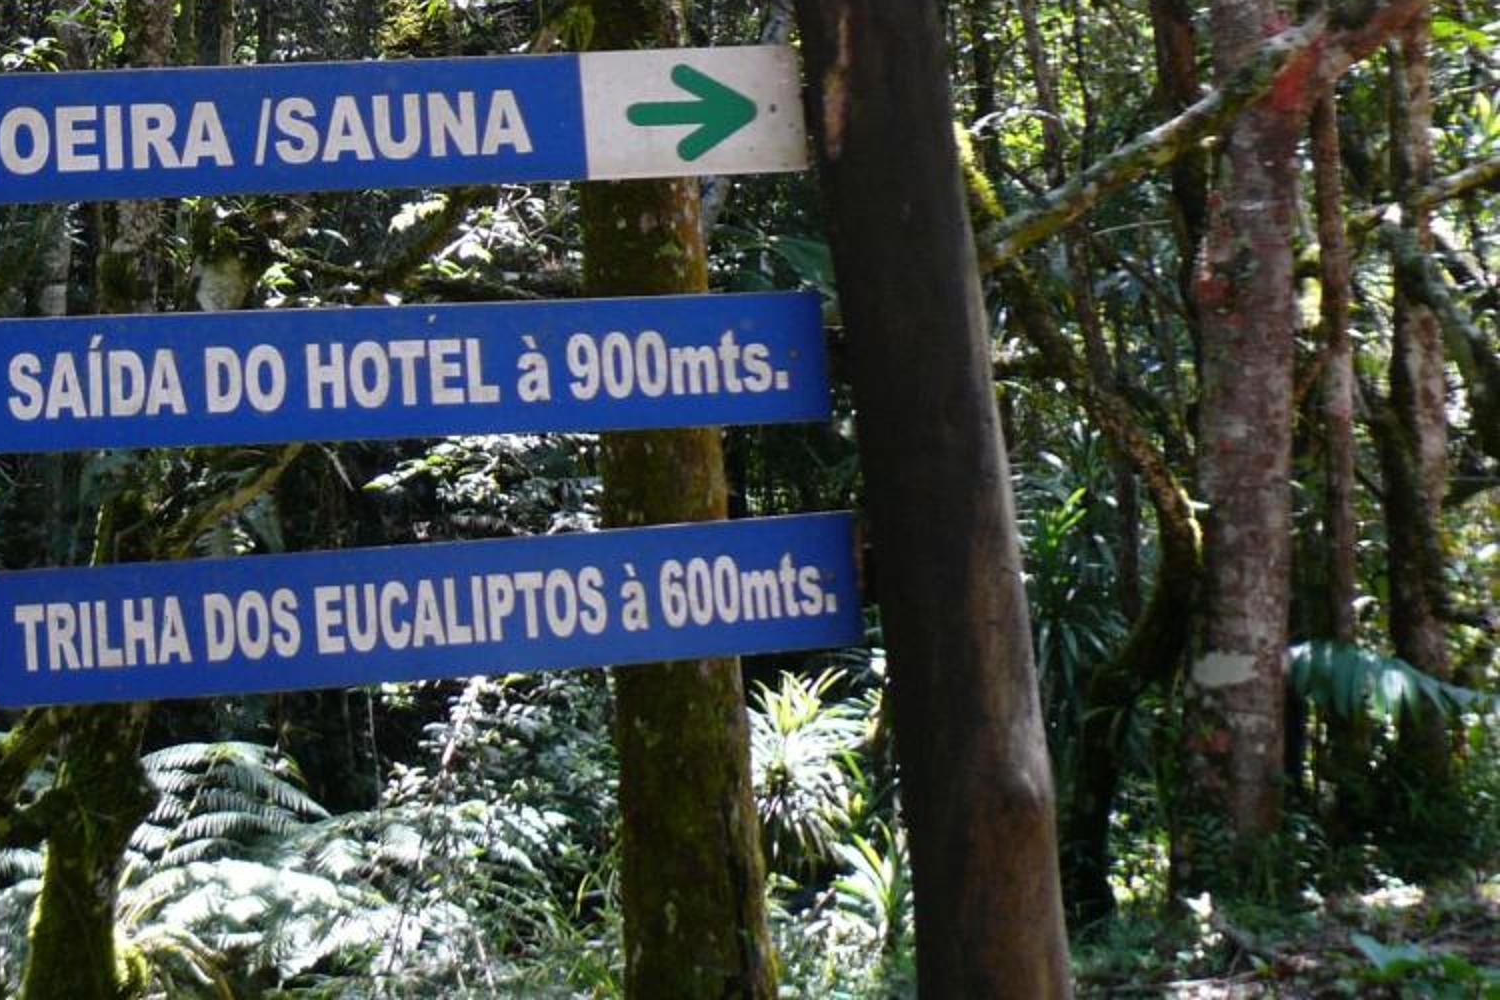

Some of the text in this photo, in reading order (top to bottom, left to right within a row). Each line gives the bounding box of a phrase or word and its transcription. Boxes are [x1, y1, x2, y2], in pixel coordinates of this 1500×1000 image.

[255, 89, 533, 165] /SAUNA
[9, 331, 789, 420] SAÍDA DO HOTEL à 900mts.
[15, 555, 836, 671] TRILHA DOS EUCALIPTOS à 600mts.
